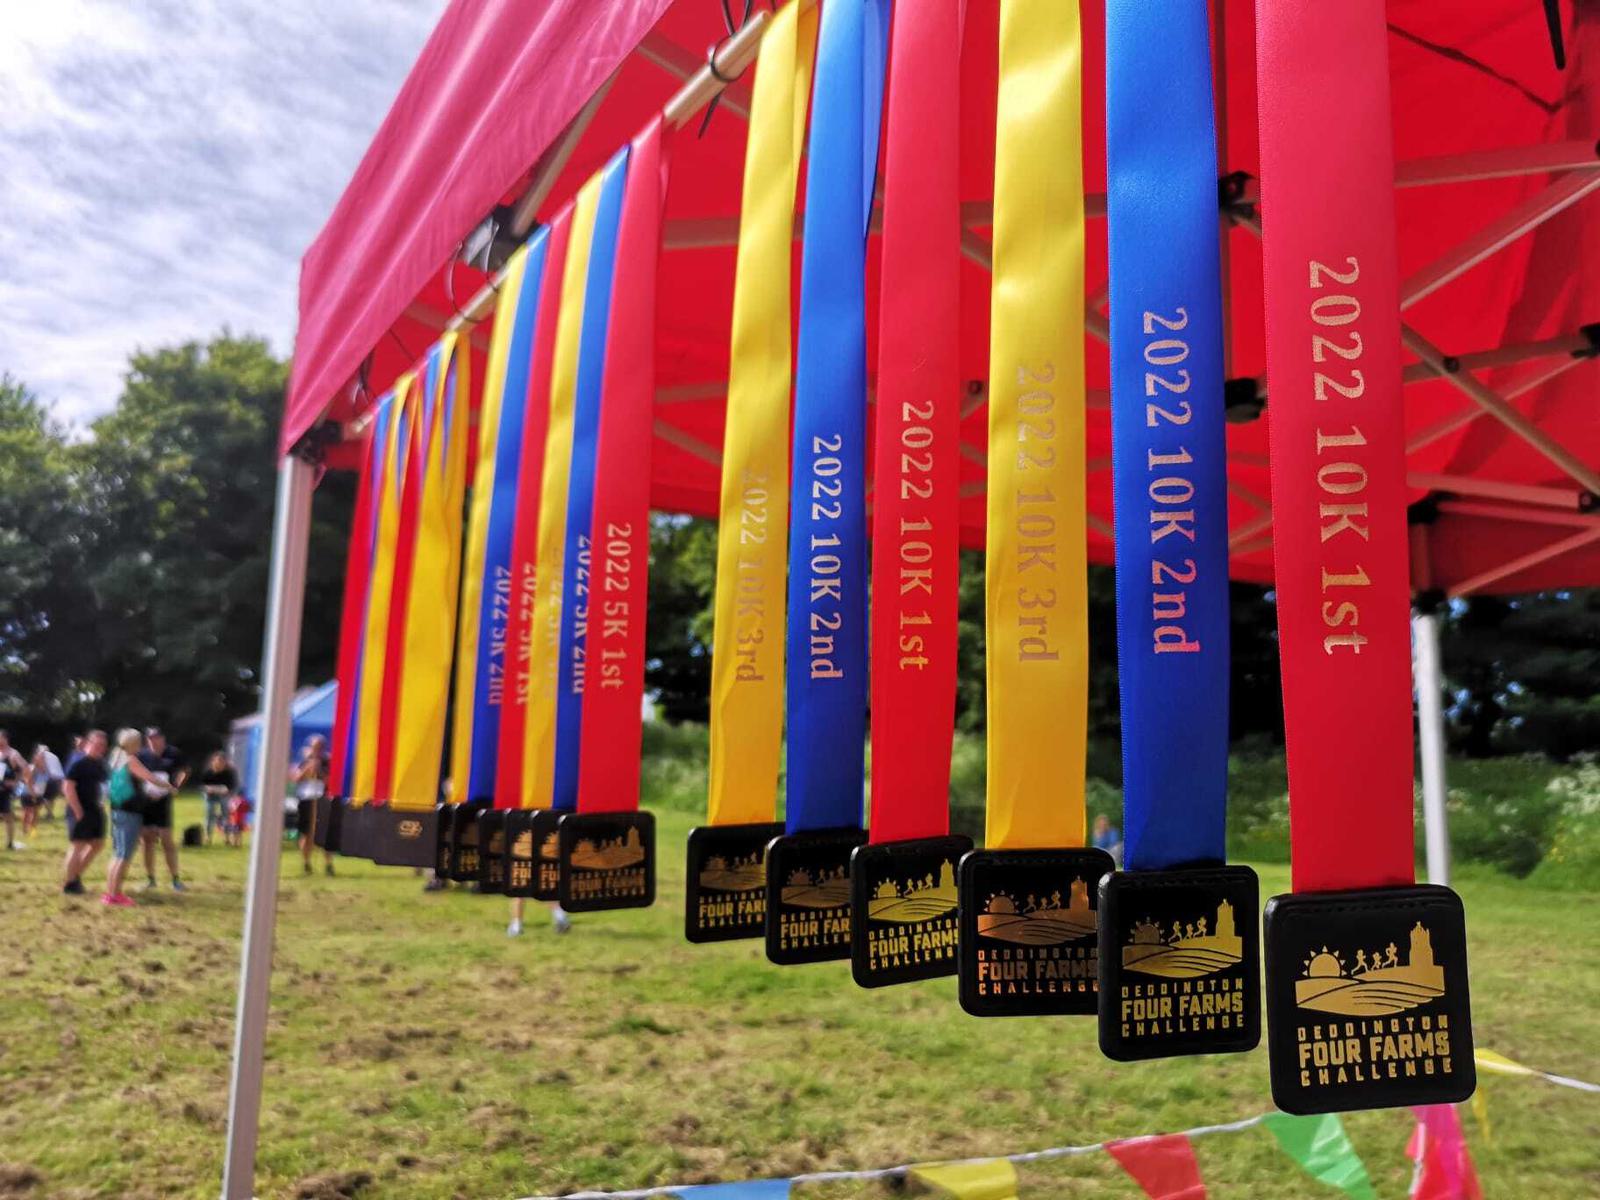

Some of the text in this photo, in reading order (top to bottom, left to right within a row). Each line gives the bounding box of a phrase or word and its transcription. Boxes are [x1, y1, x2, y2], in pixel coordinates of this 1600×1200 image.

[1308, 256, 1372, 656] 2022 10K 1st
[1142, 307, 1199, 654] 2022 10K 2nd
[1015, 363, 1060, 662] 2022 10K 3rd
[899, 400, 934, 671] 2022 10K 1st
[810, 434, 844, 680] 2022 10K 2nd
[735, 466, 769, 682] 2022 10K 3rd
[601, 523, 632, 689] 2022 5K 1st
[699, 891, 765, 904] DEDDINGT
[699, 899, 767, 918] FOUR FAR
[698, 914, 767, 928] CHALLEN
[781, 907, 852, 923] DEDDINGT
[781, 917, 851, 937] FOUR FAR
[781, 933, 852, 950] CHALLEN
[869, 936, 909, 958] FOUR
[870, 947, 954, 970] CHALLENG
[978, 958, 1098, 981] FOUR FARMS
[1121, 978, 1243, 998] DEDDINGTON
[1121, 992, 1243, 1022] FOUR FARMS
[1121, 1014, 1244, 1038] CHALLENGE
[1298, 1015, 1449, 1042] DEDDINGTON
[1299, 1031, 1450, 1070] FOUR FARMS
[1300, 1057, 1453, 1087] CHALLENGE
